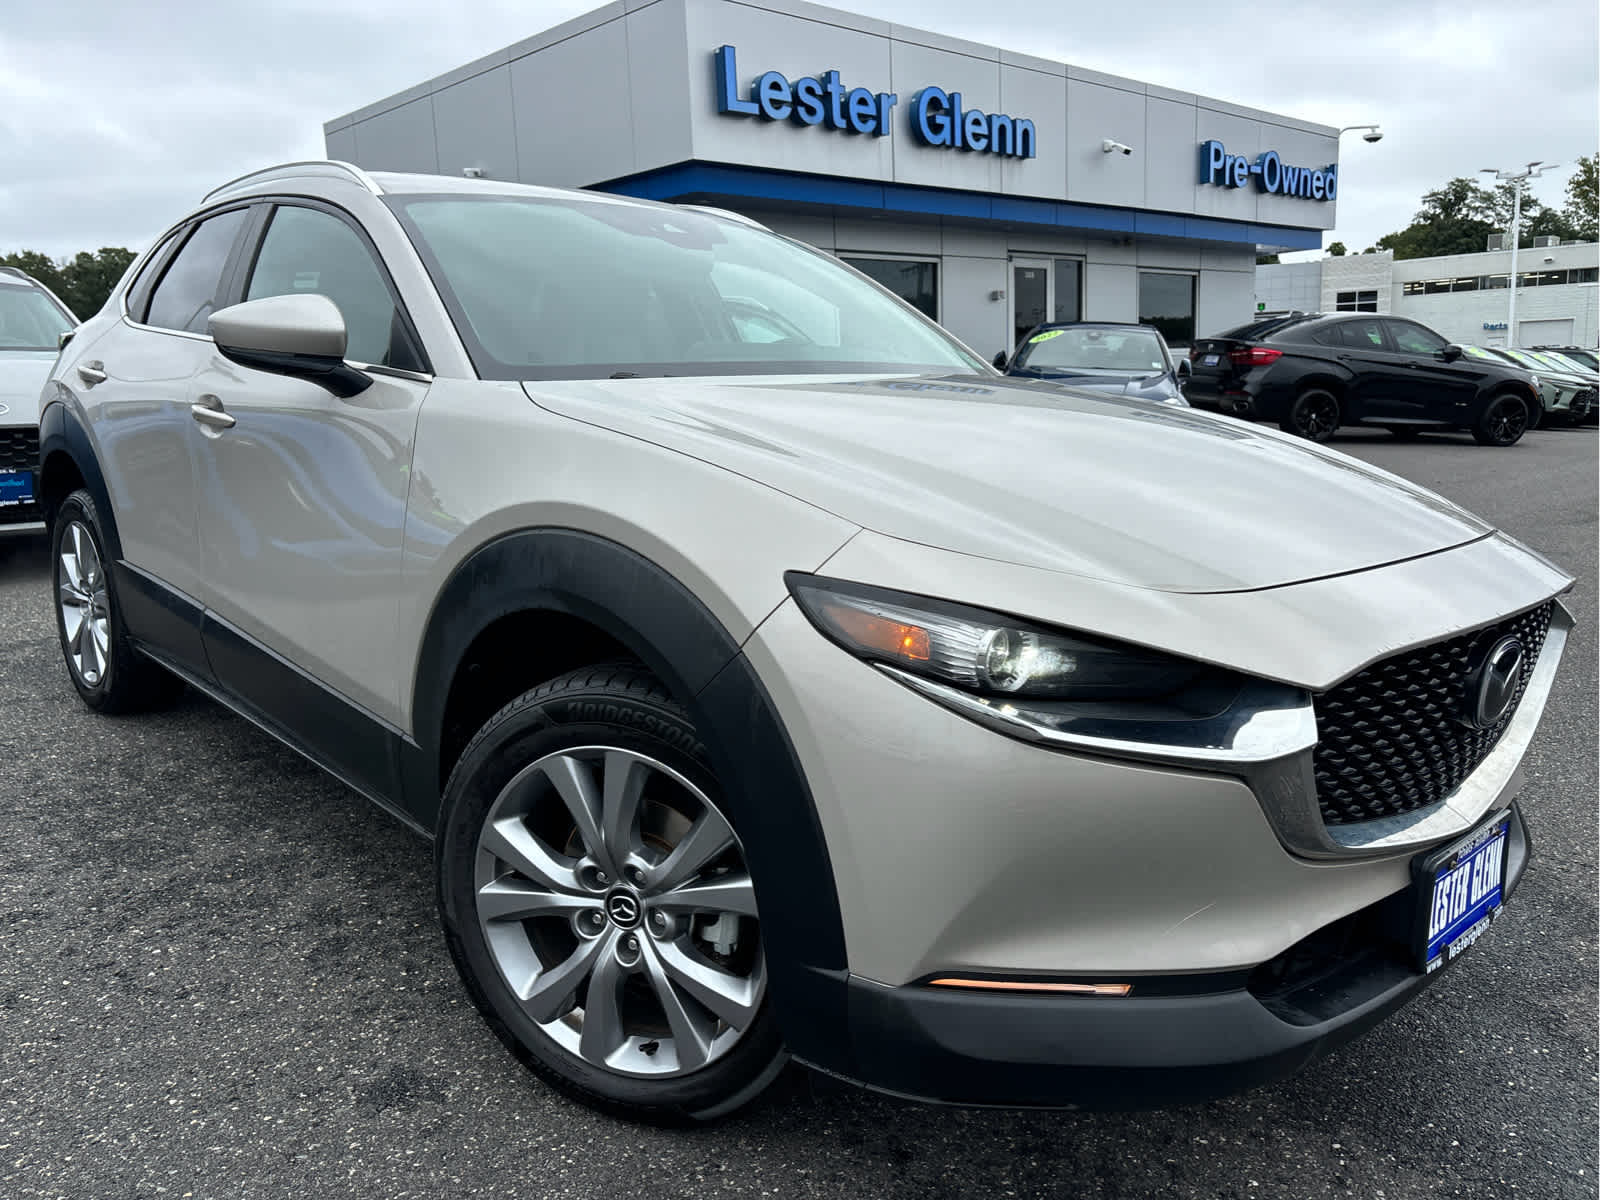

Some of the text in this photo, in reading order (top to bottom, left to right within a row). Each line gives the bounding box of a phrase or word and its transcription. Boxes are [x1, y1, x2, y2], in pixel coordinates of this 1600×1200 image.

[715, 45, 1036, 159] Lester Glenn
[1201, 140, 1337, 200] Pre-Owned
[1428, 861, 1471, 940] LESTER
[1470, 835, 1505, 905] GLENN
